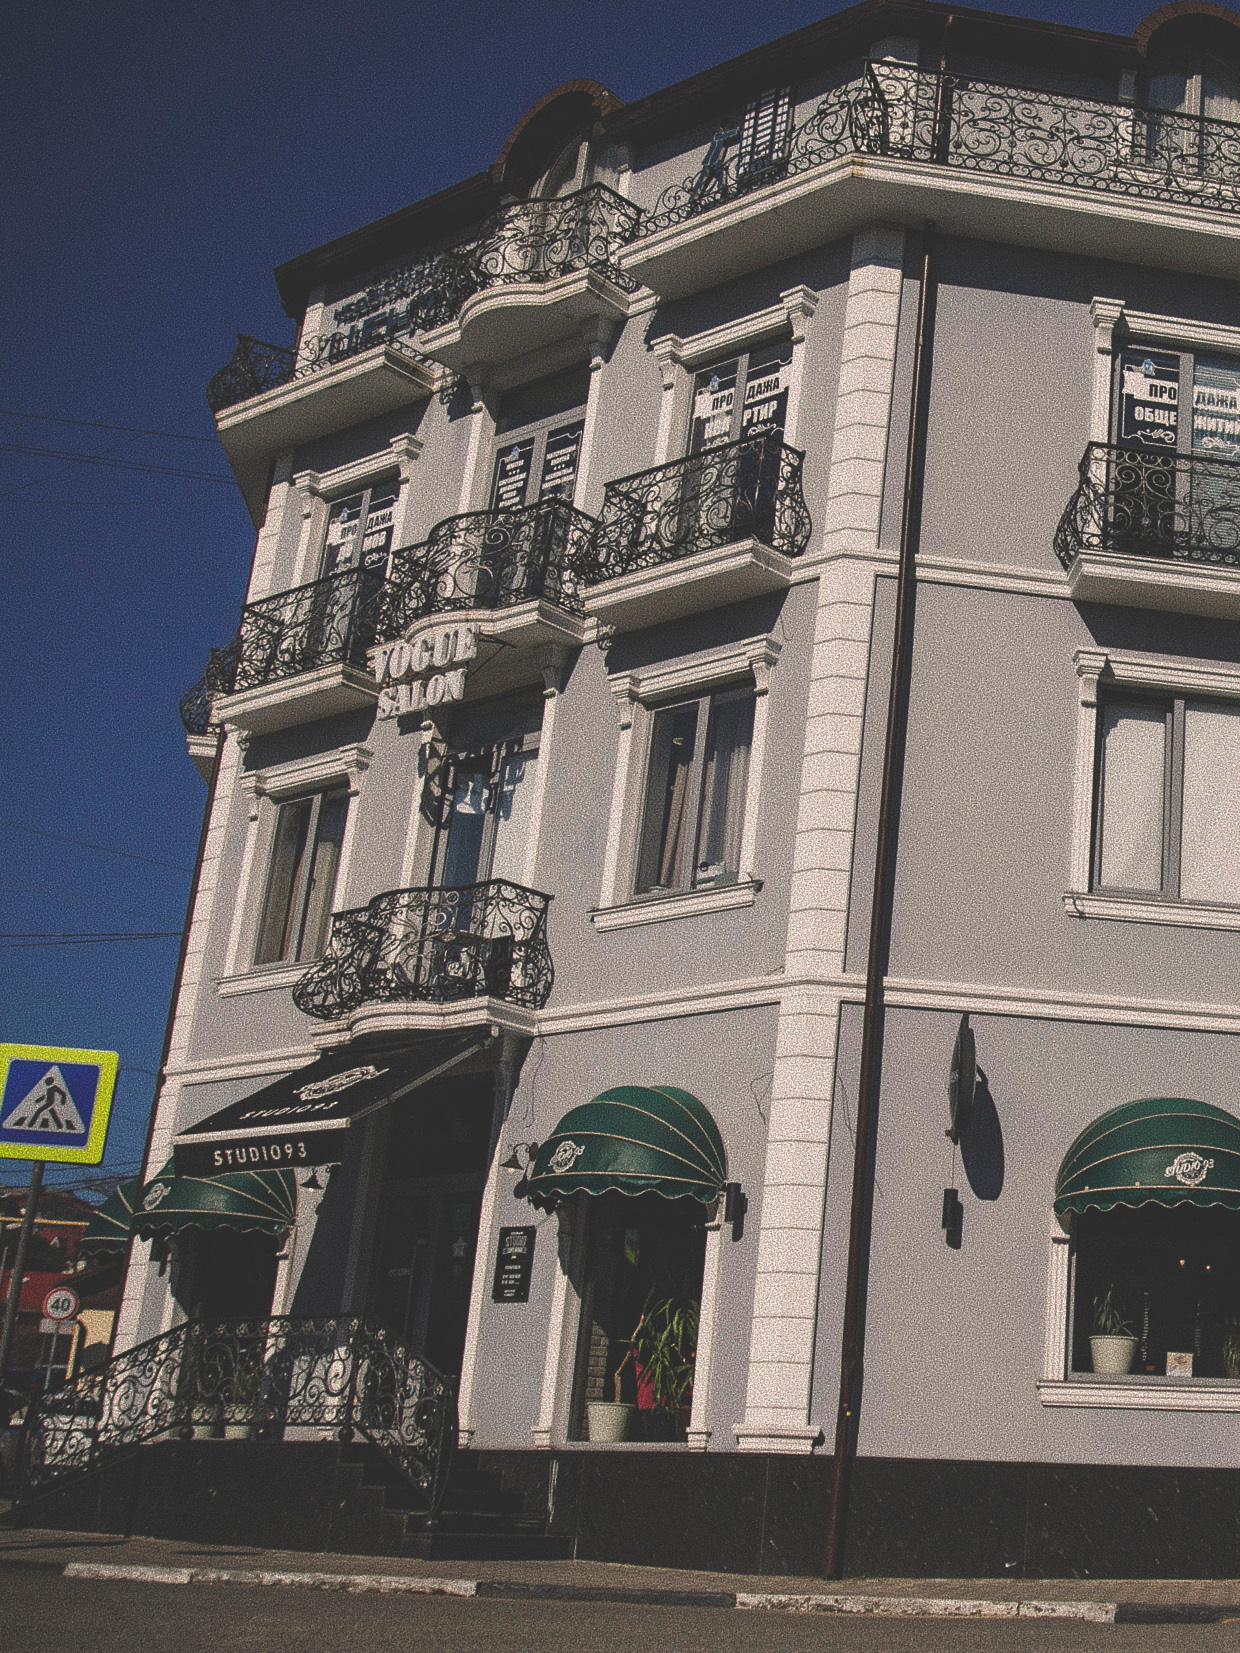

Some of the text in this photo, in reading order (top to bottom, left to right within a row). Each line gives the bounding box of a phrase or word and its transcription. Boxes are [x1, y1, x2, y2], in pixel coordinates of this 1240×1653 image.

[712, 377, 780, 412] ПРО ДАЖА
[1149, 383, 1238, 409] ПРО ДАЖА
[742, 400, 778, 427] РТИР
[1134, 406, 1177, 426] ОБЩЕ
[51, 1298, 71, 1312] 40
